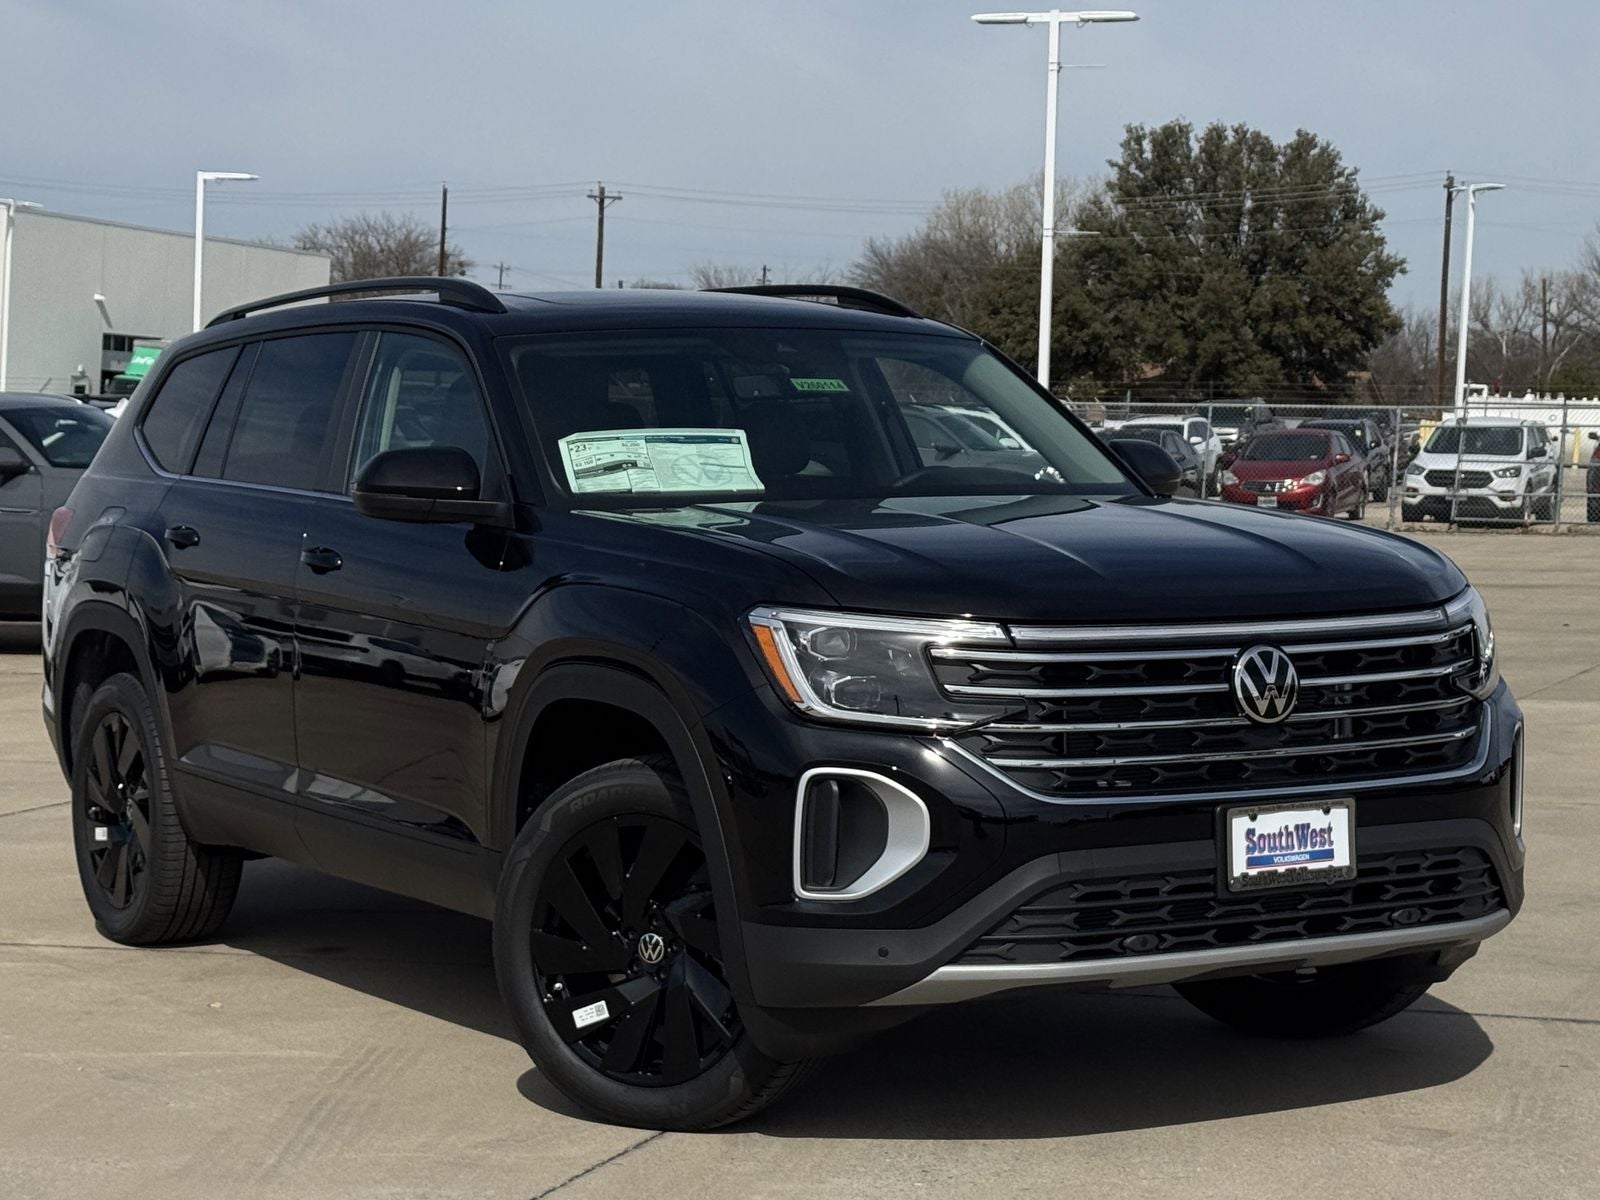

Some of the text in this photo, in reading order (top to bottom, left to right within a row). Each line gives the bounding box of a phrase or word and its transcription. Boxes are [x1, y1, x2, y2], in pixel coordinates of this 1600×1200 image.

[574, 443, 587, 453] 23
[1244, 821, 1335, 856] SouthWest
[1272, 853, 1310, 865] VOLKSWAGEN
